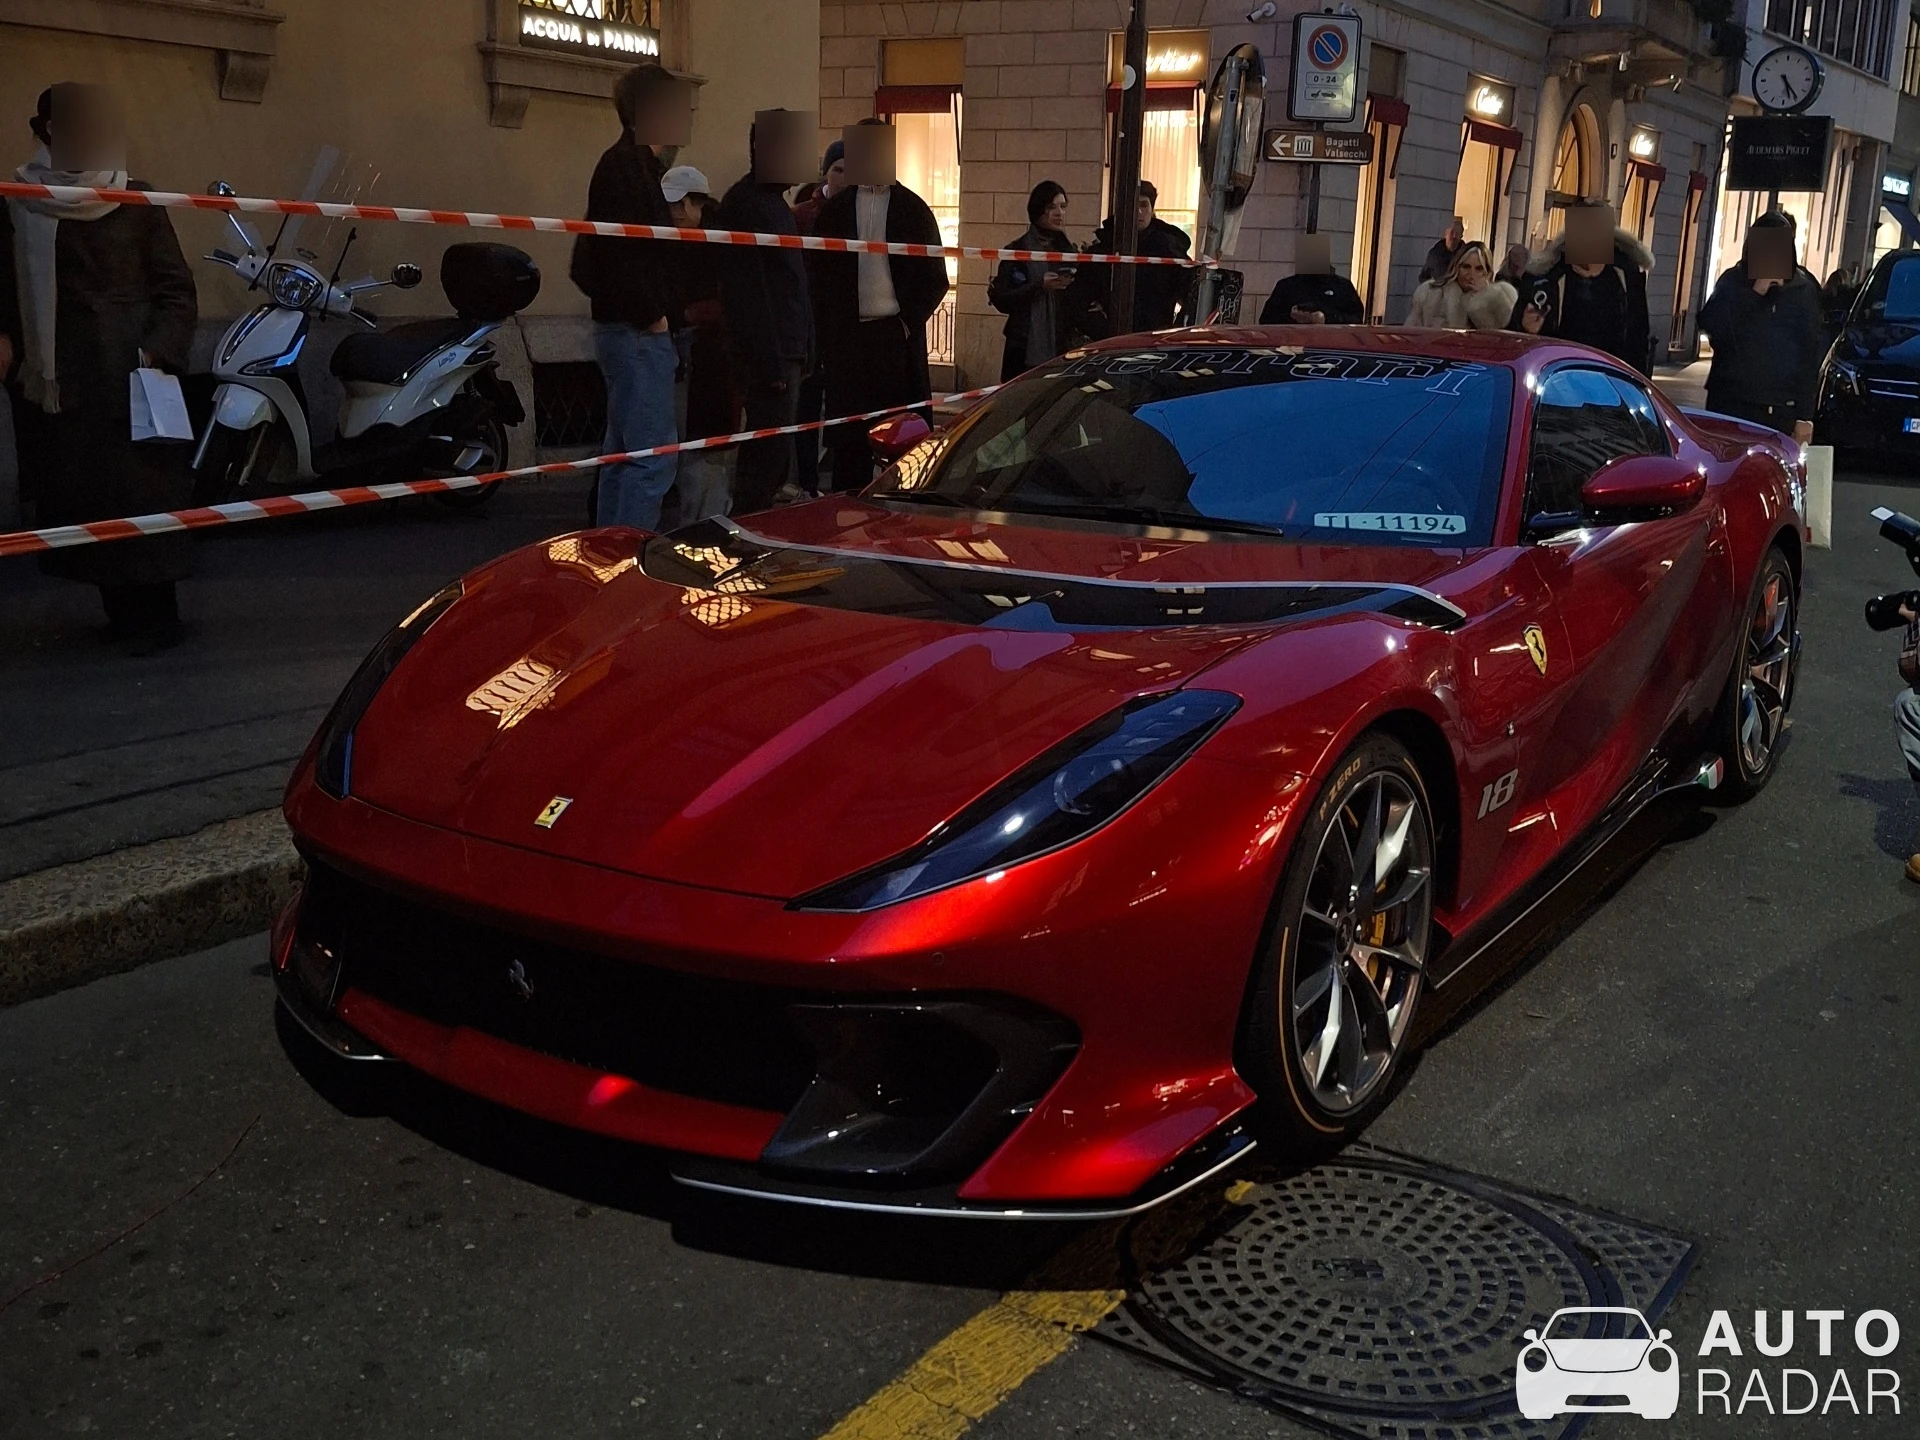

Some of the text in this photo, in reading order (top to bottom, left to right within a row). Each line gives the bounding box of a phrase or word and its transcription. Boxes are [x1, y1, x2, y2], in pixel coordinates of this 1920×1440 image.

[522, 17, 582, 44] ACQUA
[604, 28, 659, 57] PARMA
[1313, 75, 1319, 83] 0
[1326, 75, 1337, 83] 24
[1326, 137, 1360, 148] Bagatti
[1325, 148, 1368, 159] Valsecchi
[1323, 515, 1350, 529] TI
[1375, 515, 1457, 532] 11194
[1319, 757, 1361, 821] P ZERO
[1476, 768, 1518, 821] 18
